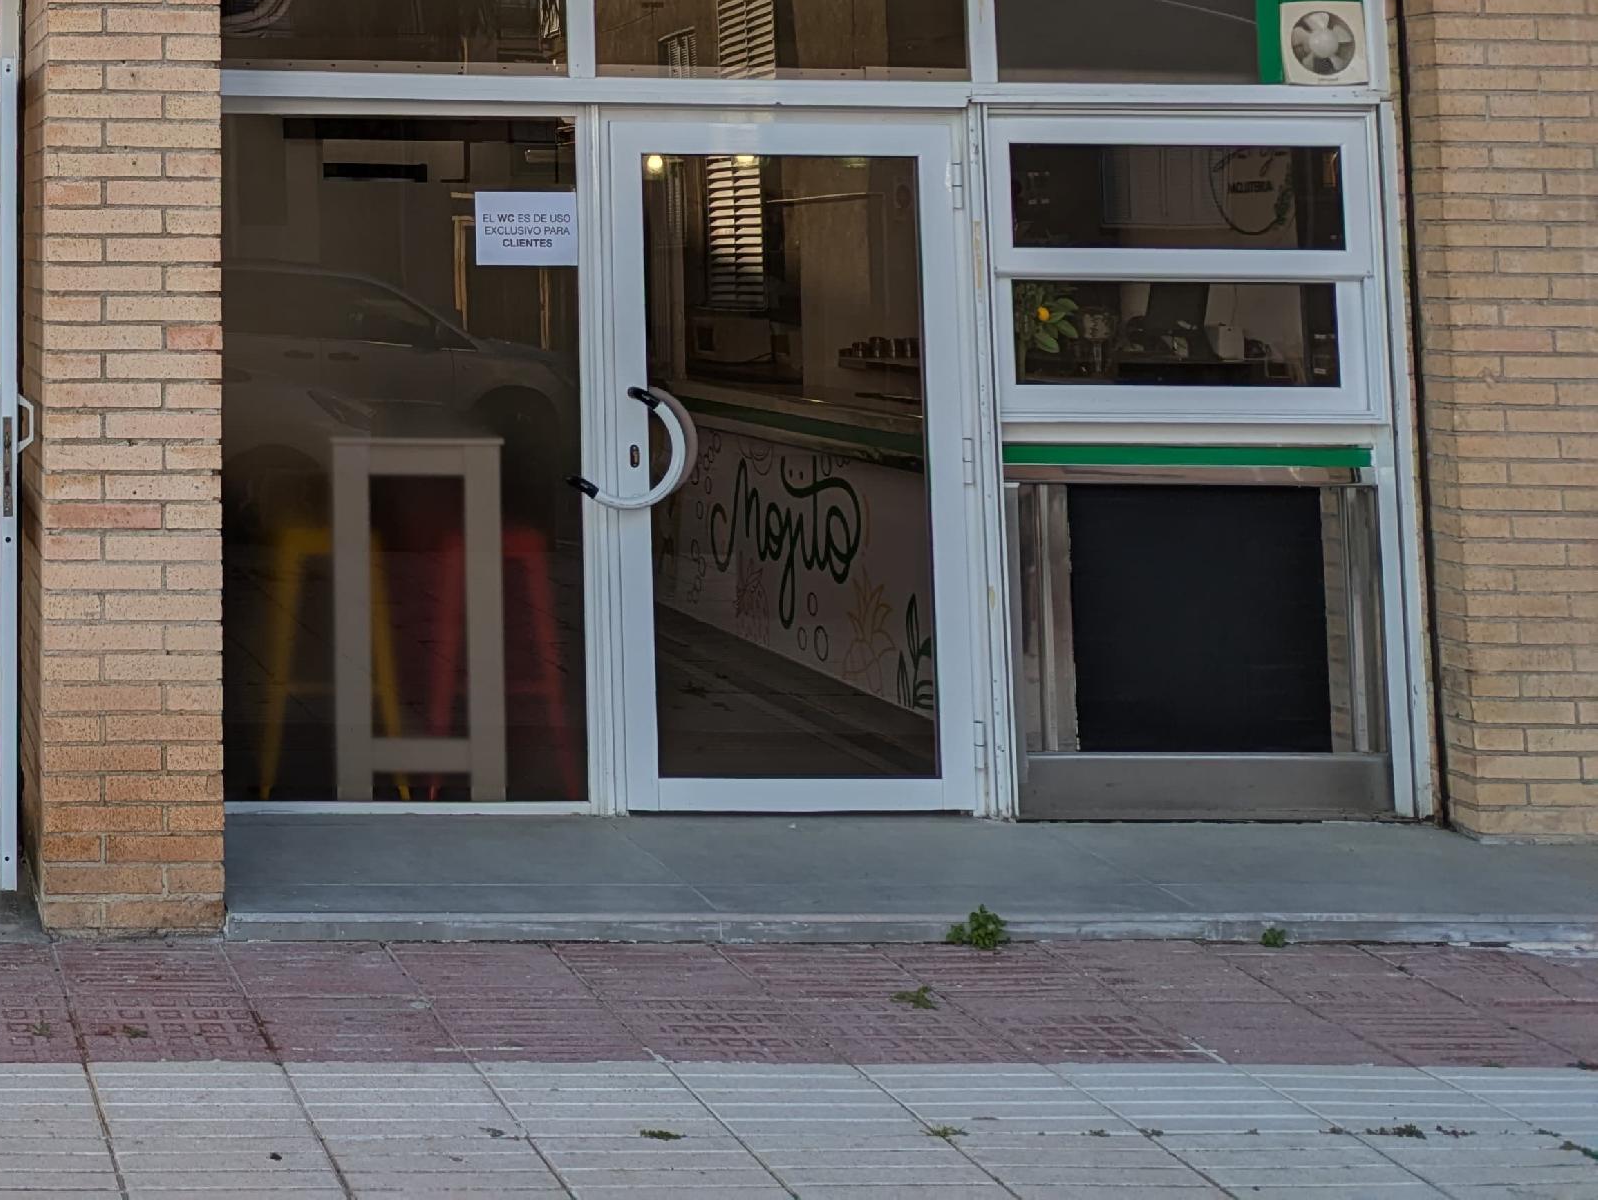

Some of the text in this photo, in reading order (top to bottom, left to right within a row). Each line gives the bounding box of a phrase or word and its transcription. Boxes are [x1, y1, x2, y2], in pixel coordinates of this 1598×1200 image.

[482, 213, 571, 223] EL WC ES DE USO
[484, 226, 571, 236] EXCLUSIVO PARA
[502, 238, 553, 248] CLIENTES
